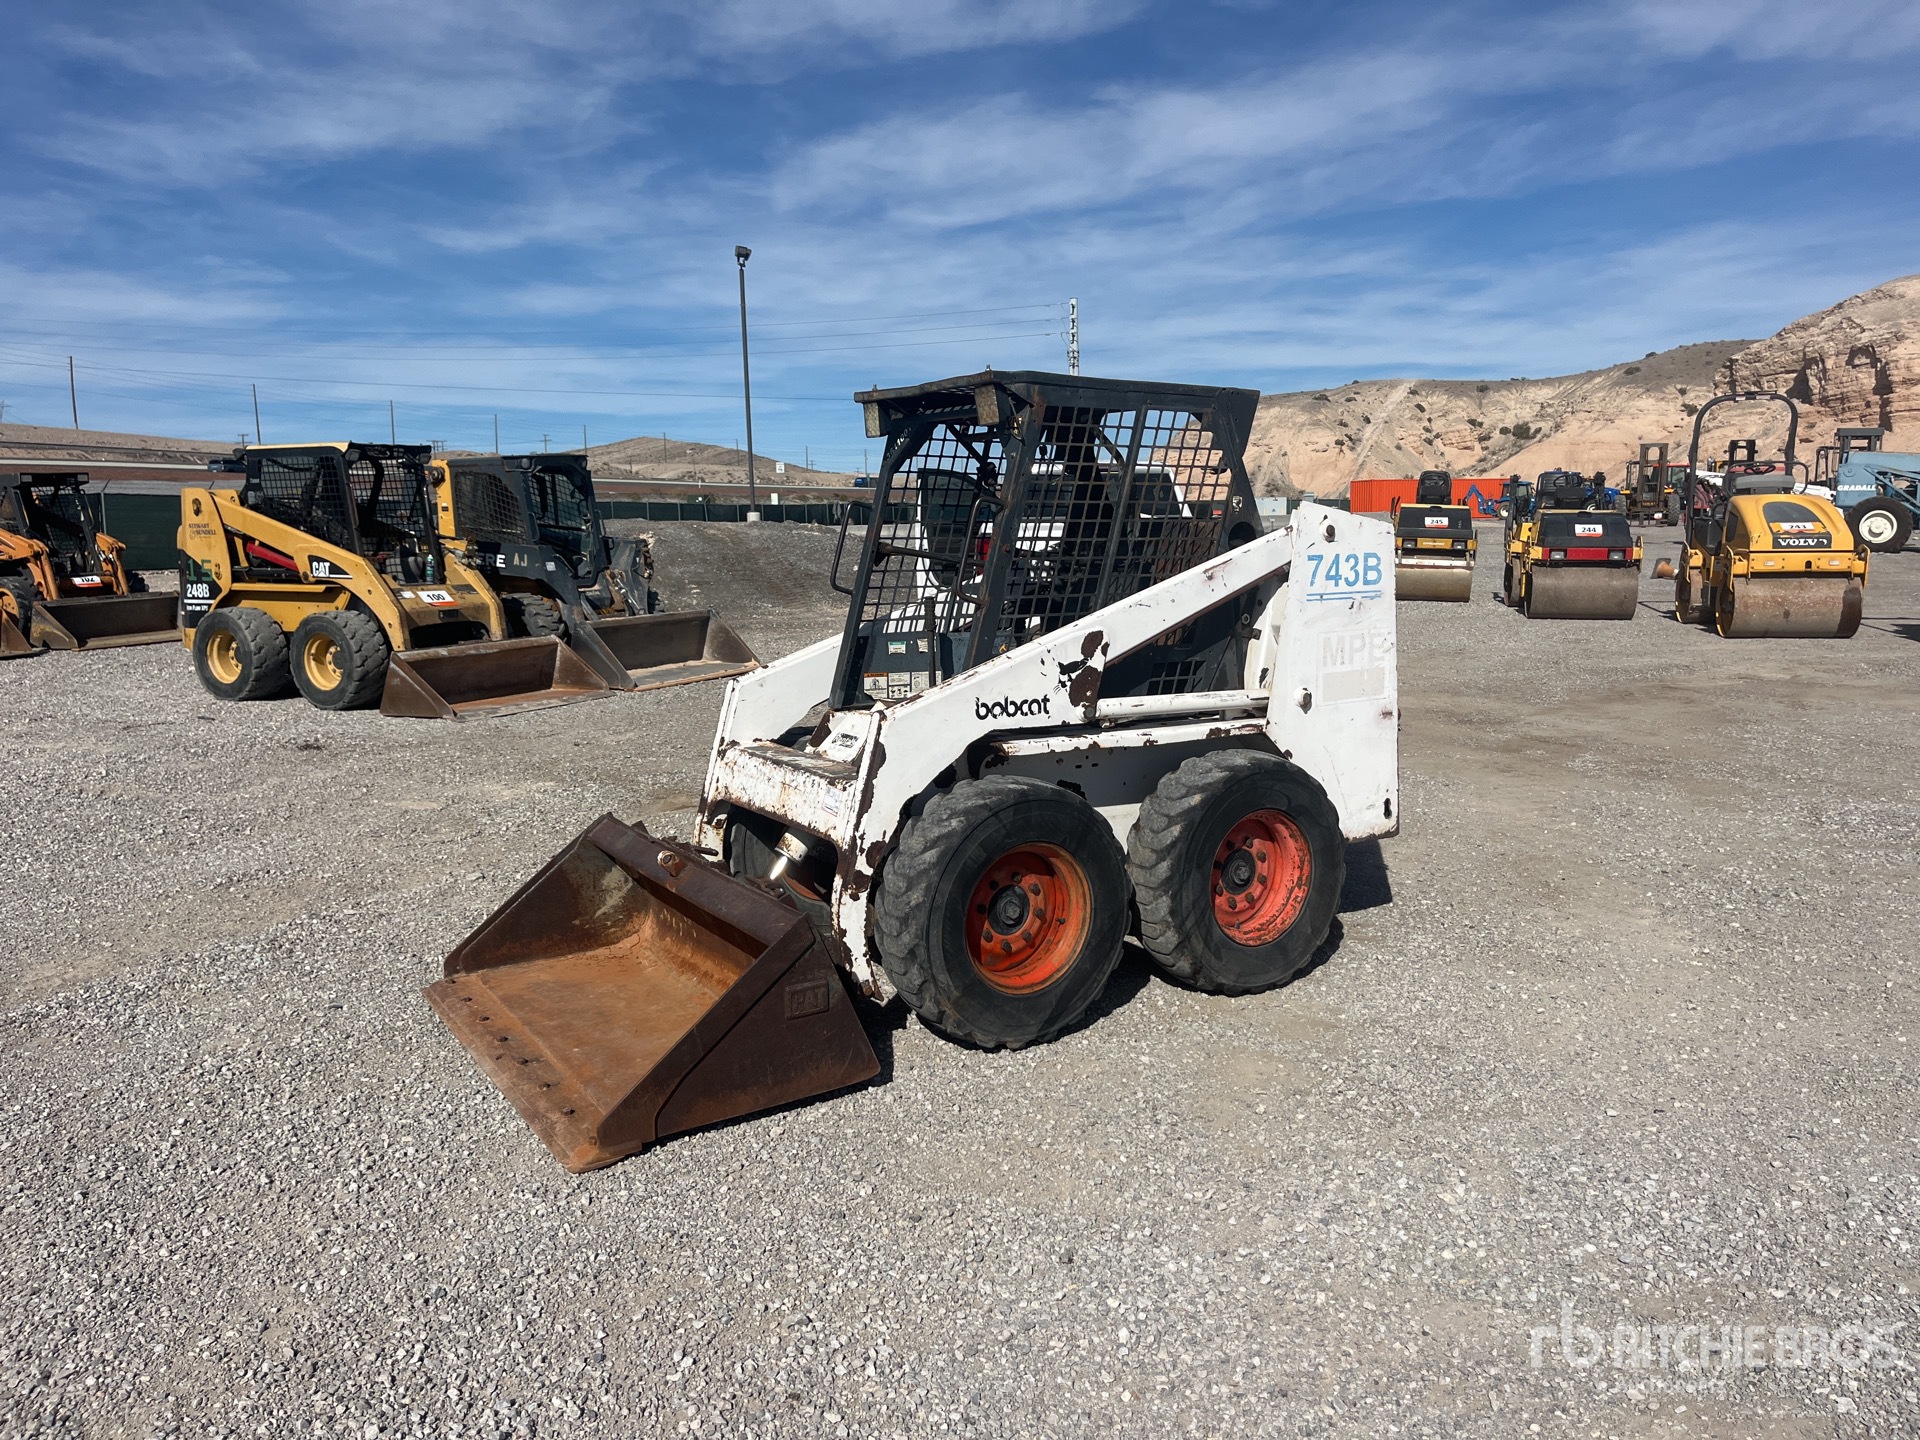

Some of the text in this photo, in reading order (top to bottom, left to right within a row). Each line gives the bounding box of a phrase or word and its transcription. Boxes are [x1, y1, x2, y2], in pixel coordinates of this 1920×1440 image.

[187, 559, 213, 582] 15
[312, 561, 331, 577] CAT
[1307, 552, 1382, 587] 743B
[186, 583, 210, 598] 248B
[427, 593, 446, 601] 100
[975, 694, 1051, 721] bobcat
